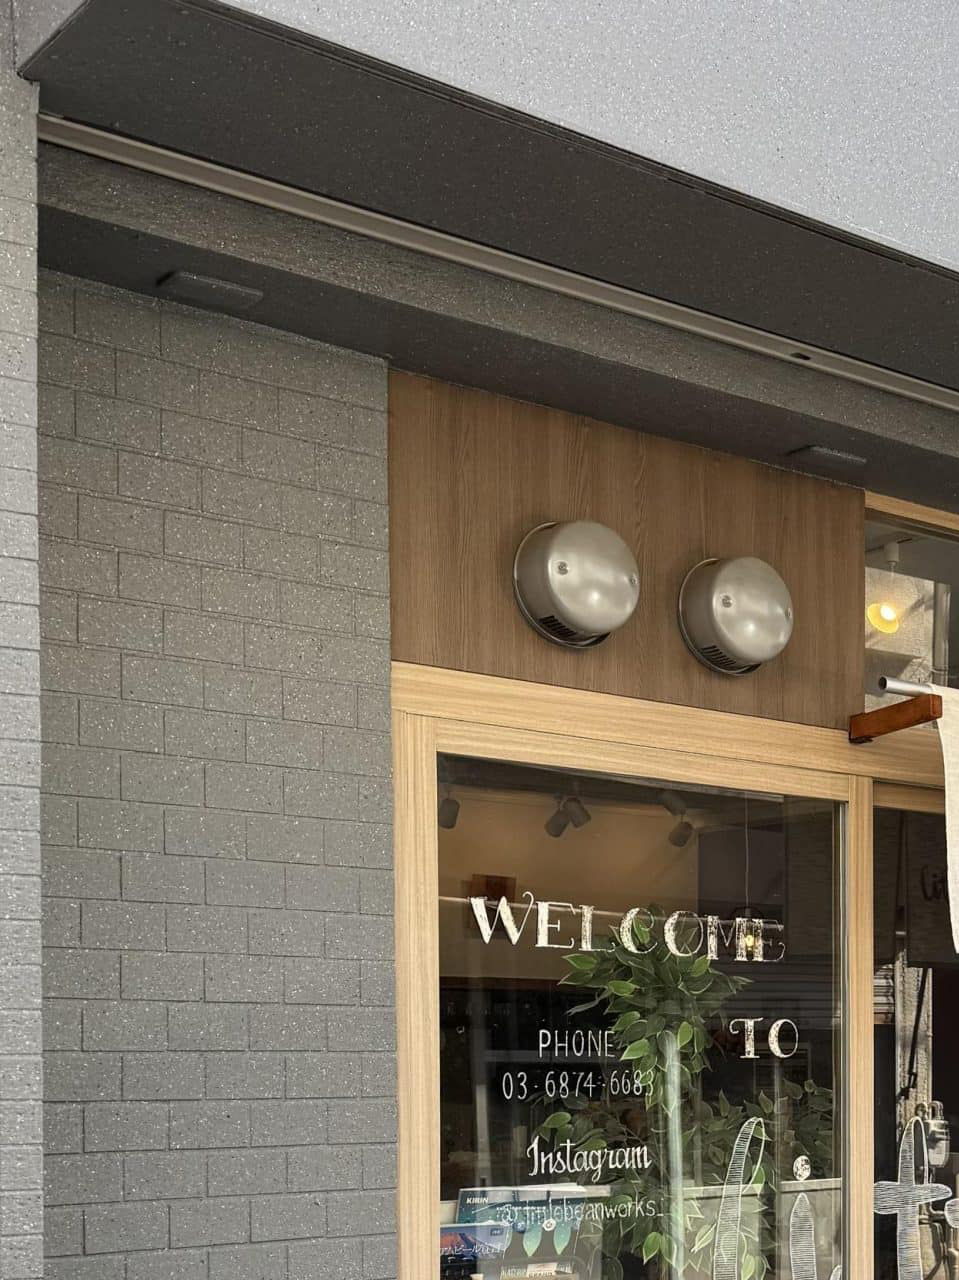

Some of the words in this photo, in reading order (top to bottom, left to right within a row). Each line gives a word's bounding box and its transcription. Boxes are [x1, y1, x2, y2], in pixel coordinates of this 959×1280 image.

[469, 891, 786, 962] WELCOME
[538, 1028, 616, 1058] PHONE
[729, 1017, 799, 1059] TO
[502, 1070, 655, 1100] 03-6874-6683
[526, 1134, 652, 1183] Instagram
